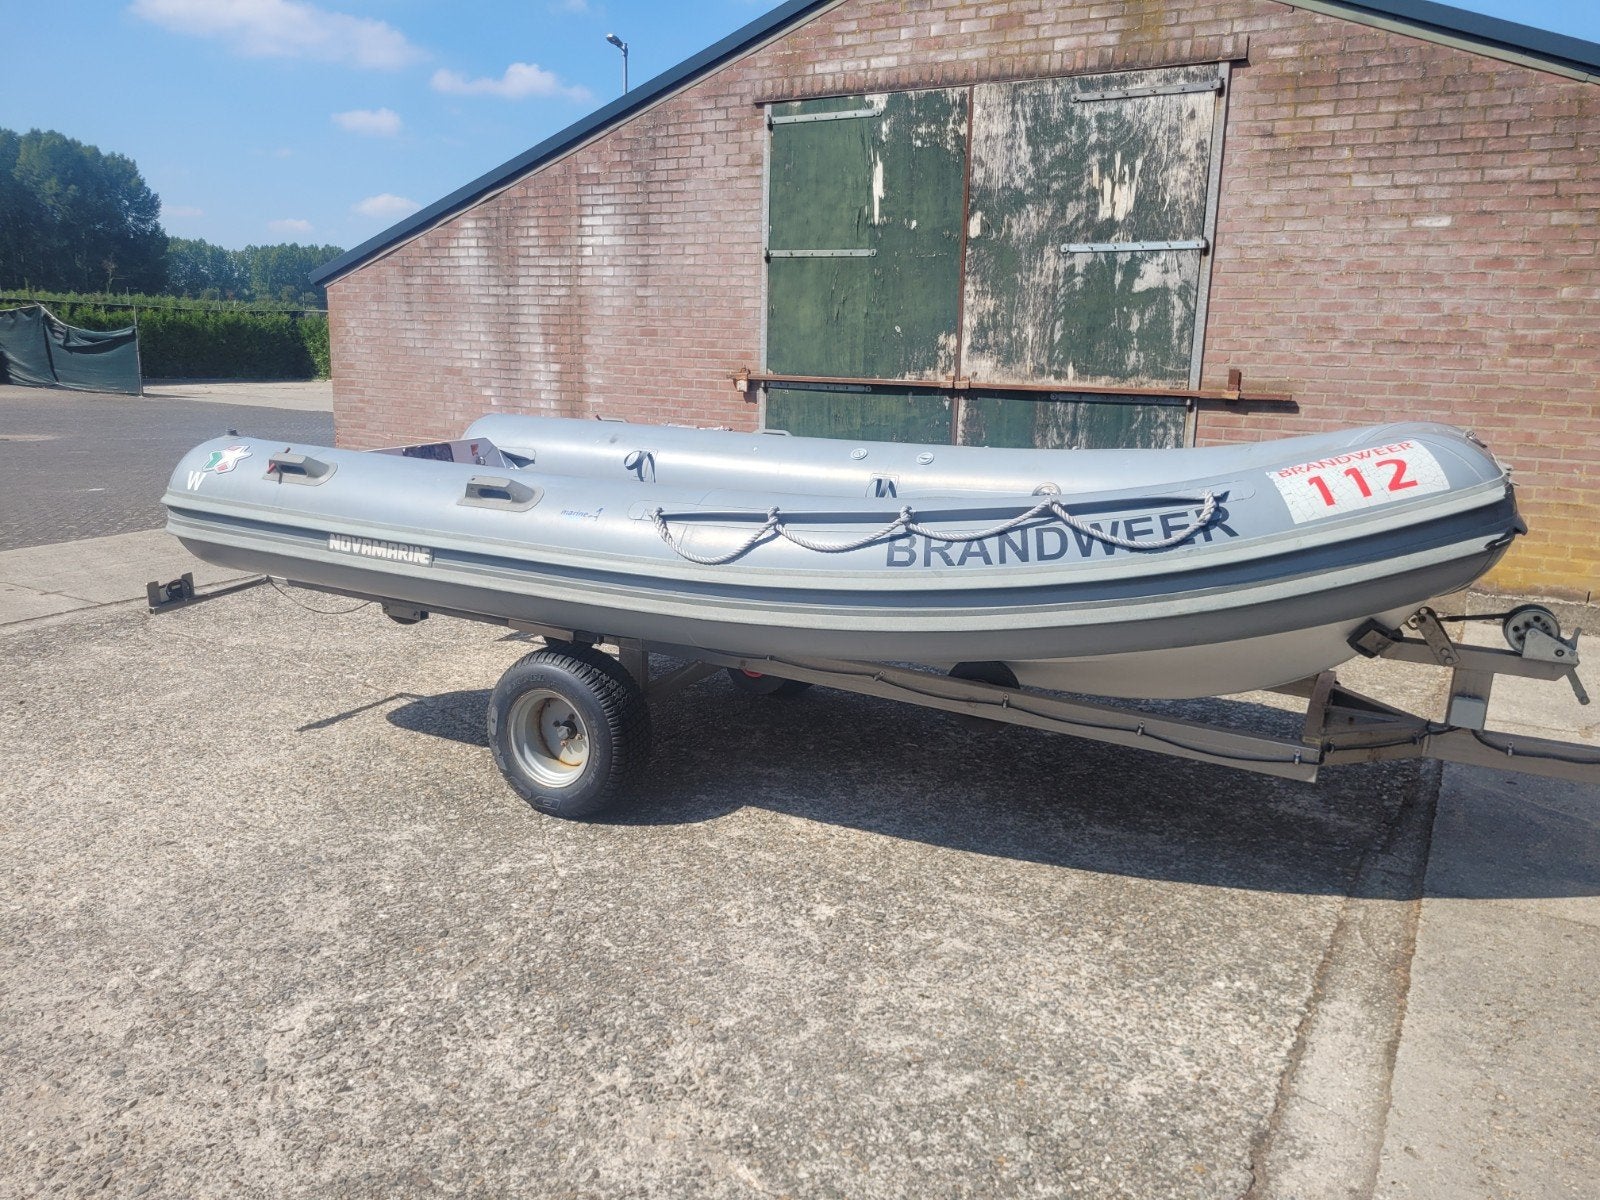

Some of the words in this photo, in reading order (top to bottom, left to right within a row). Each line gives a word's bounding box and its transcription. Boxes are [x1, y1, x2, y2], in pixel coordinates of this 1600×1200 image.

[1278, 441, 1414, 478] BRANDWEER
[1307, 458, 1418, 507] 112
[329, 533, 431, 566] NOVAMARINE
[886, 505, 1240, 568] BRANDWEER
